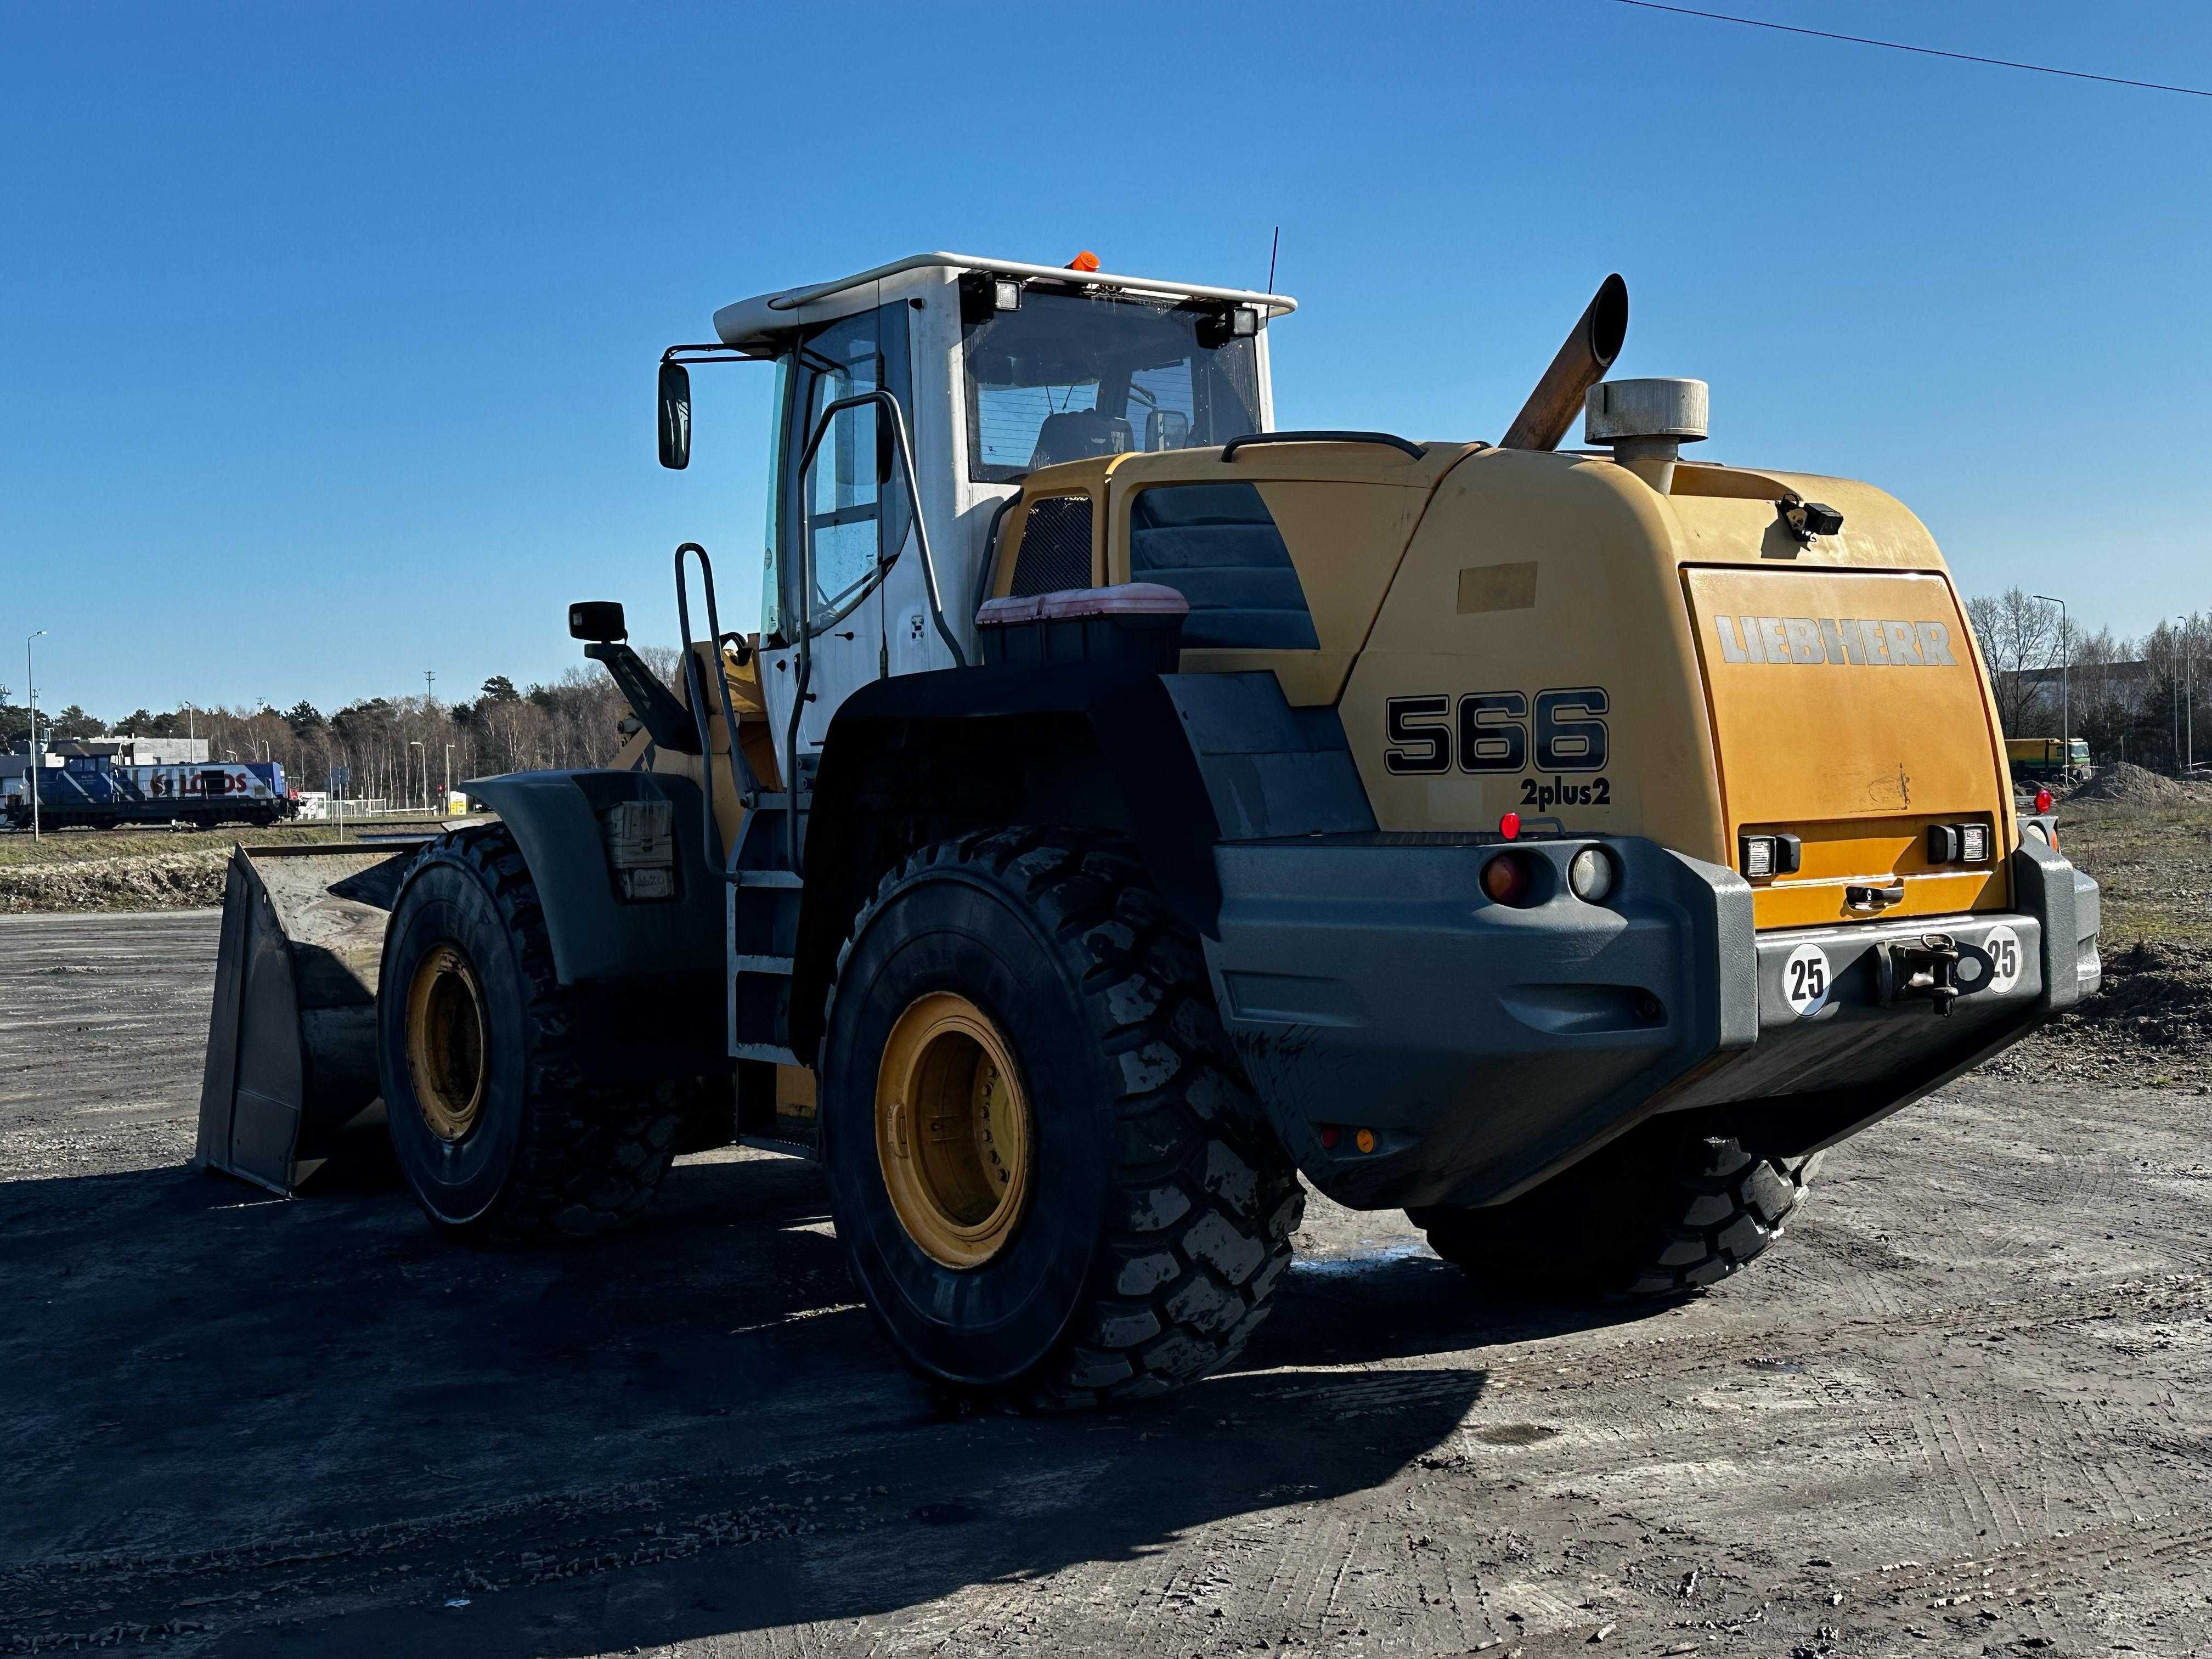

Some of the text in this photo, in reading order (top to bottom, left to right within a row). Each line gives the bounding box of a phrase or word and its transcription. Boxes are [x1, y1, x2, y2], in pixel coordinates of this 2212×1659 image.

[1713, 615, 1958, 666] LIEBHERR
[1383, 685, 1611, 776] 566
[179, 772, 247, 793] LOOS
[1520, 775, 1611, 812] 2plus2
[1790, 957, 1824, 1001] 25
[1987, 939, 2016, 979] 25
